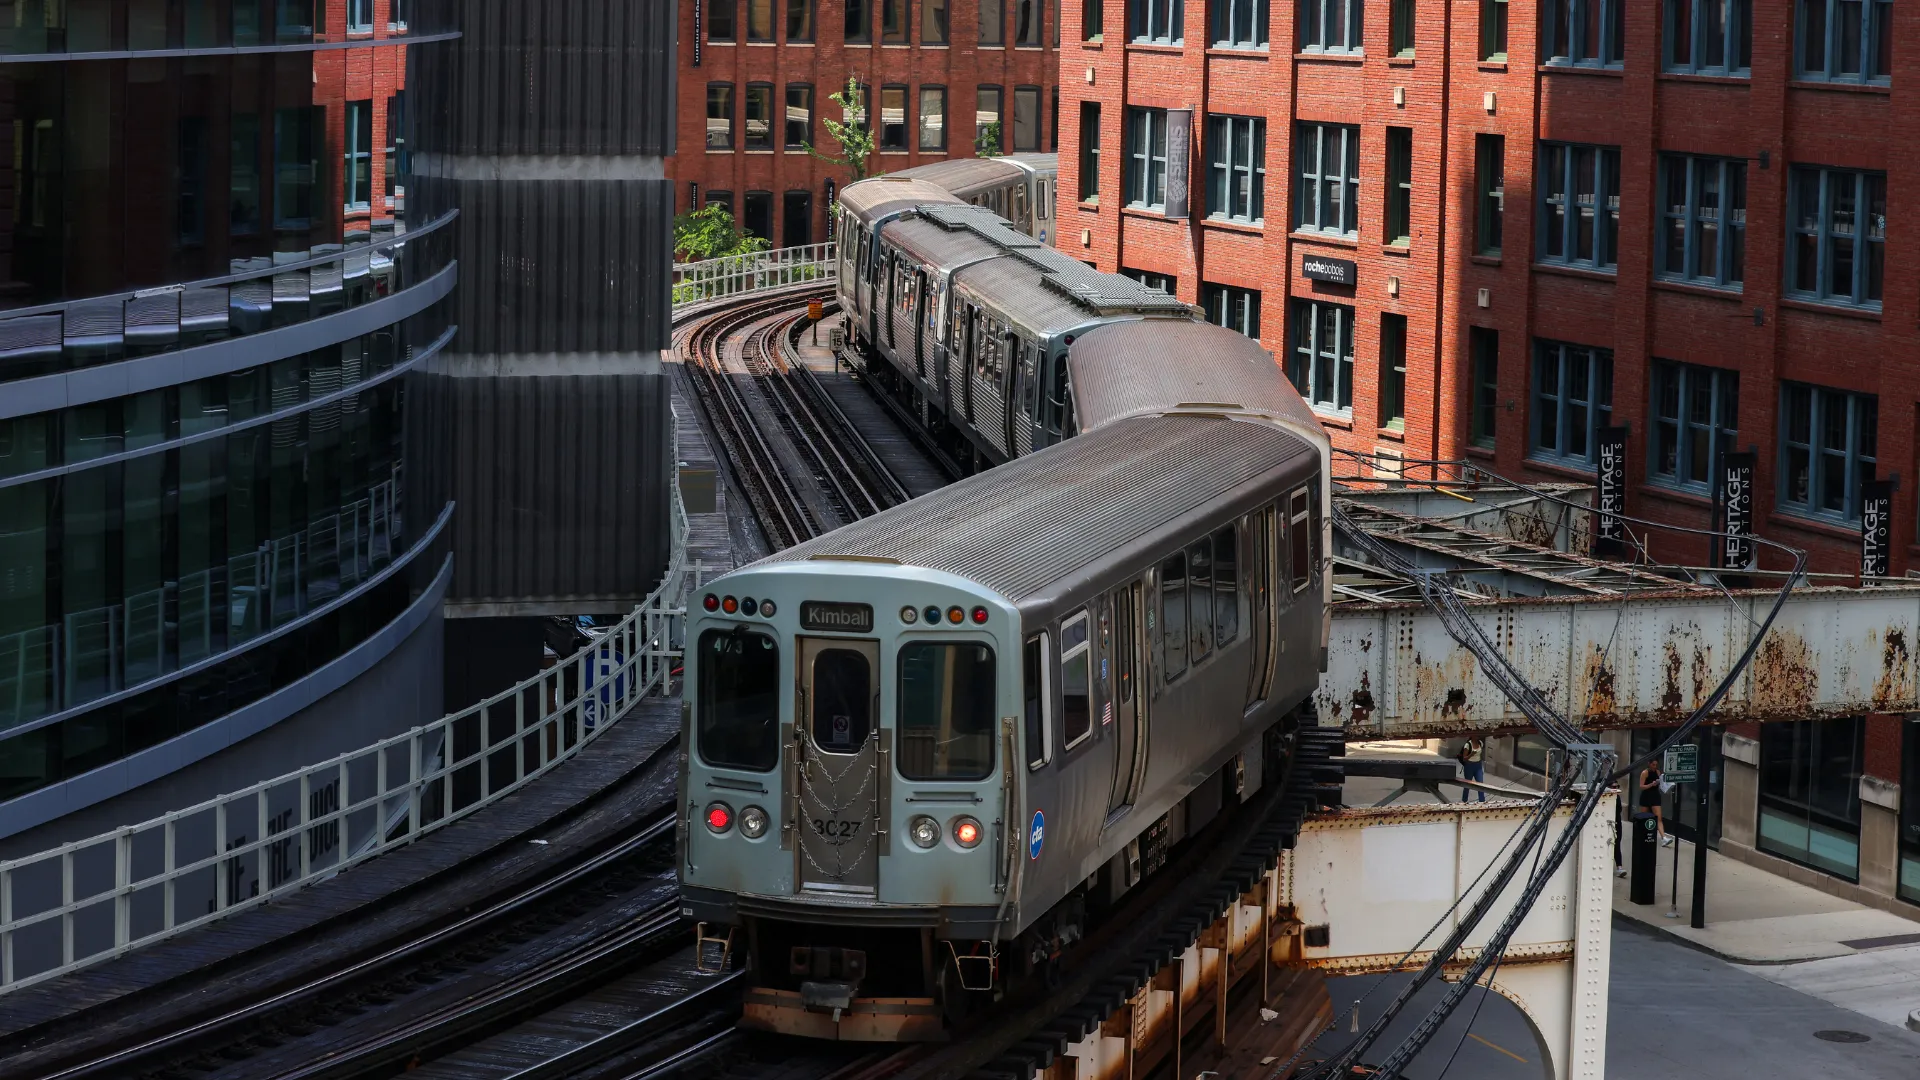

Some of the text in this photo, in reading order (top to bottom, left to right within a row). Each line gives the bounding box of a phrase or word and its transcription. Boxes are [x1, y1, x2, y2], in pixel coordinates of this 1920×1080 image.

[1169, 126, 1184, 179] SPINS
[832, 338, 843, 347] 15
[1601, 444, 1615, 538] HERITAGE
[1726, 468, 1740, 567] HERITAGE
[1863, 500, 1878, 588] ERITAGE
[809, 607, 869, 626] Kimball
[813, 819, 861, 837] 3027
[1032, 825, 1043, 845] cta
